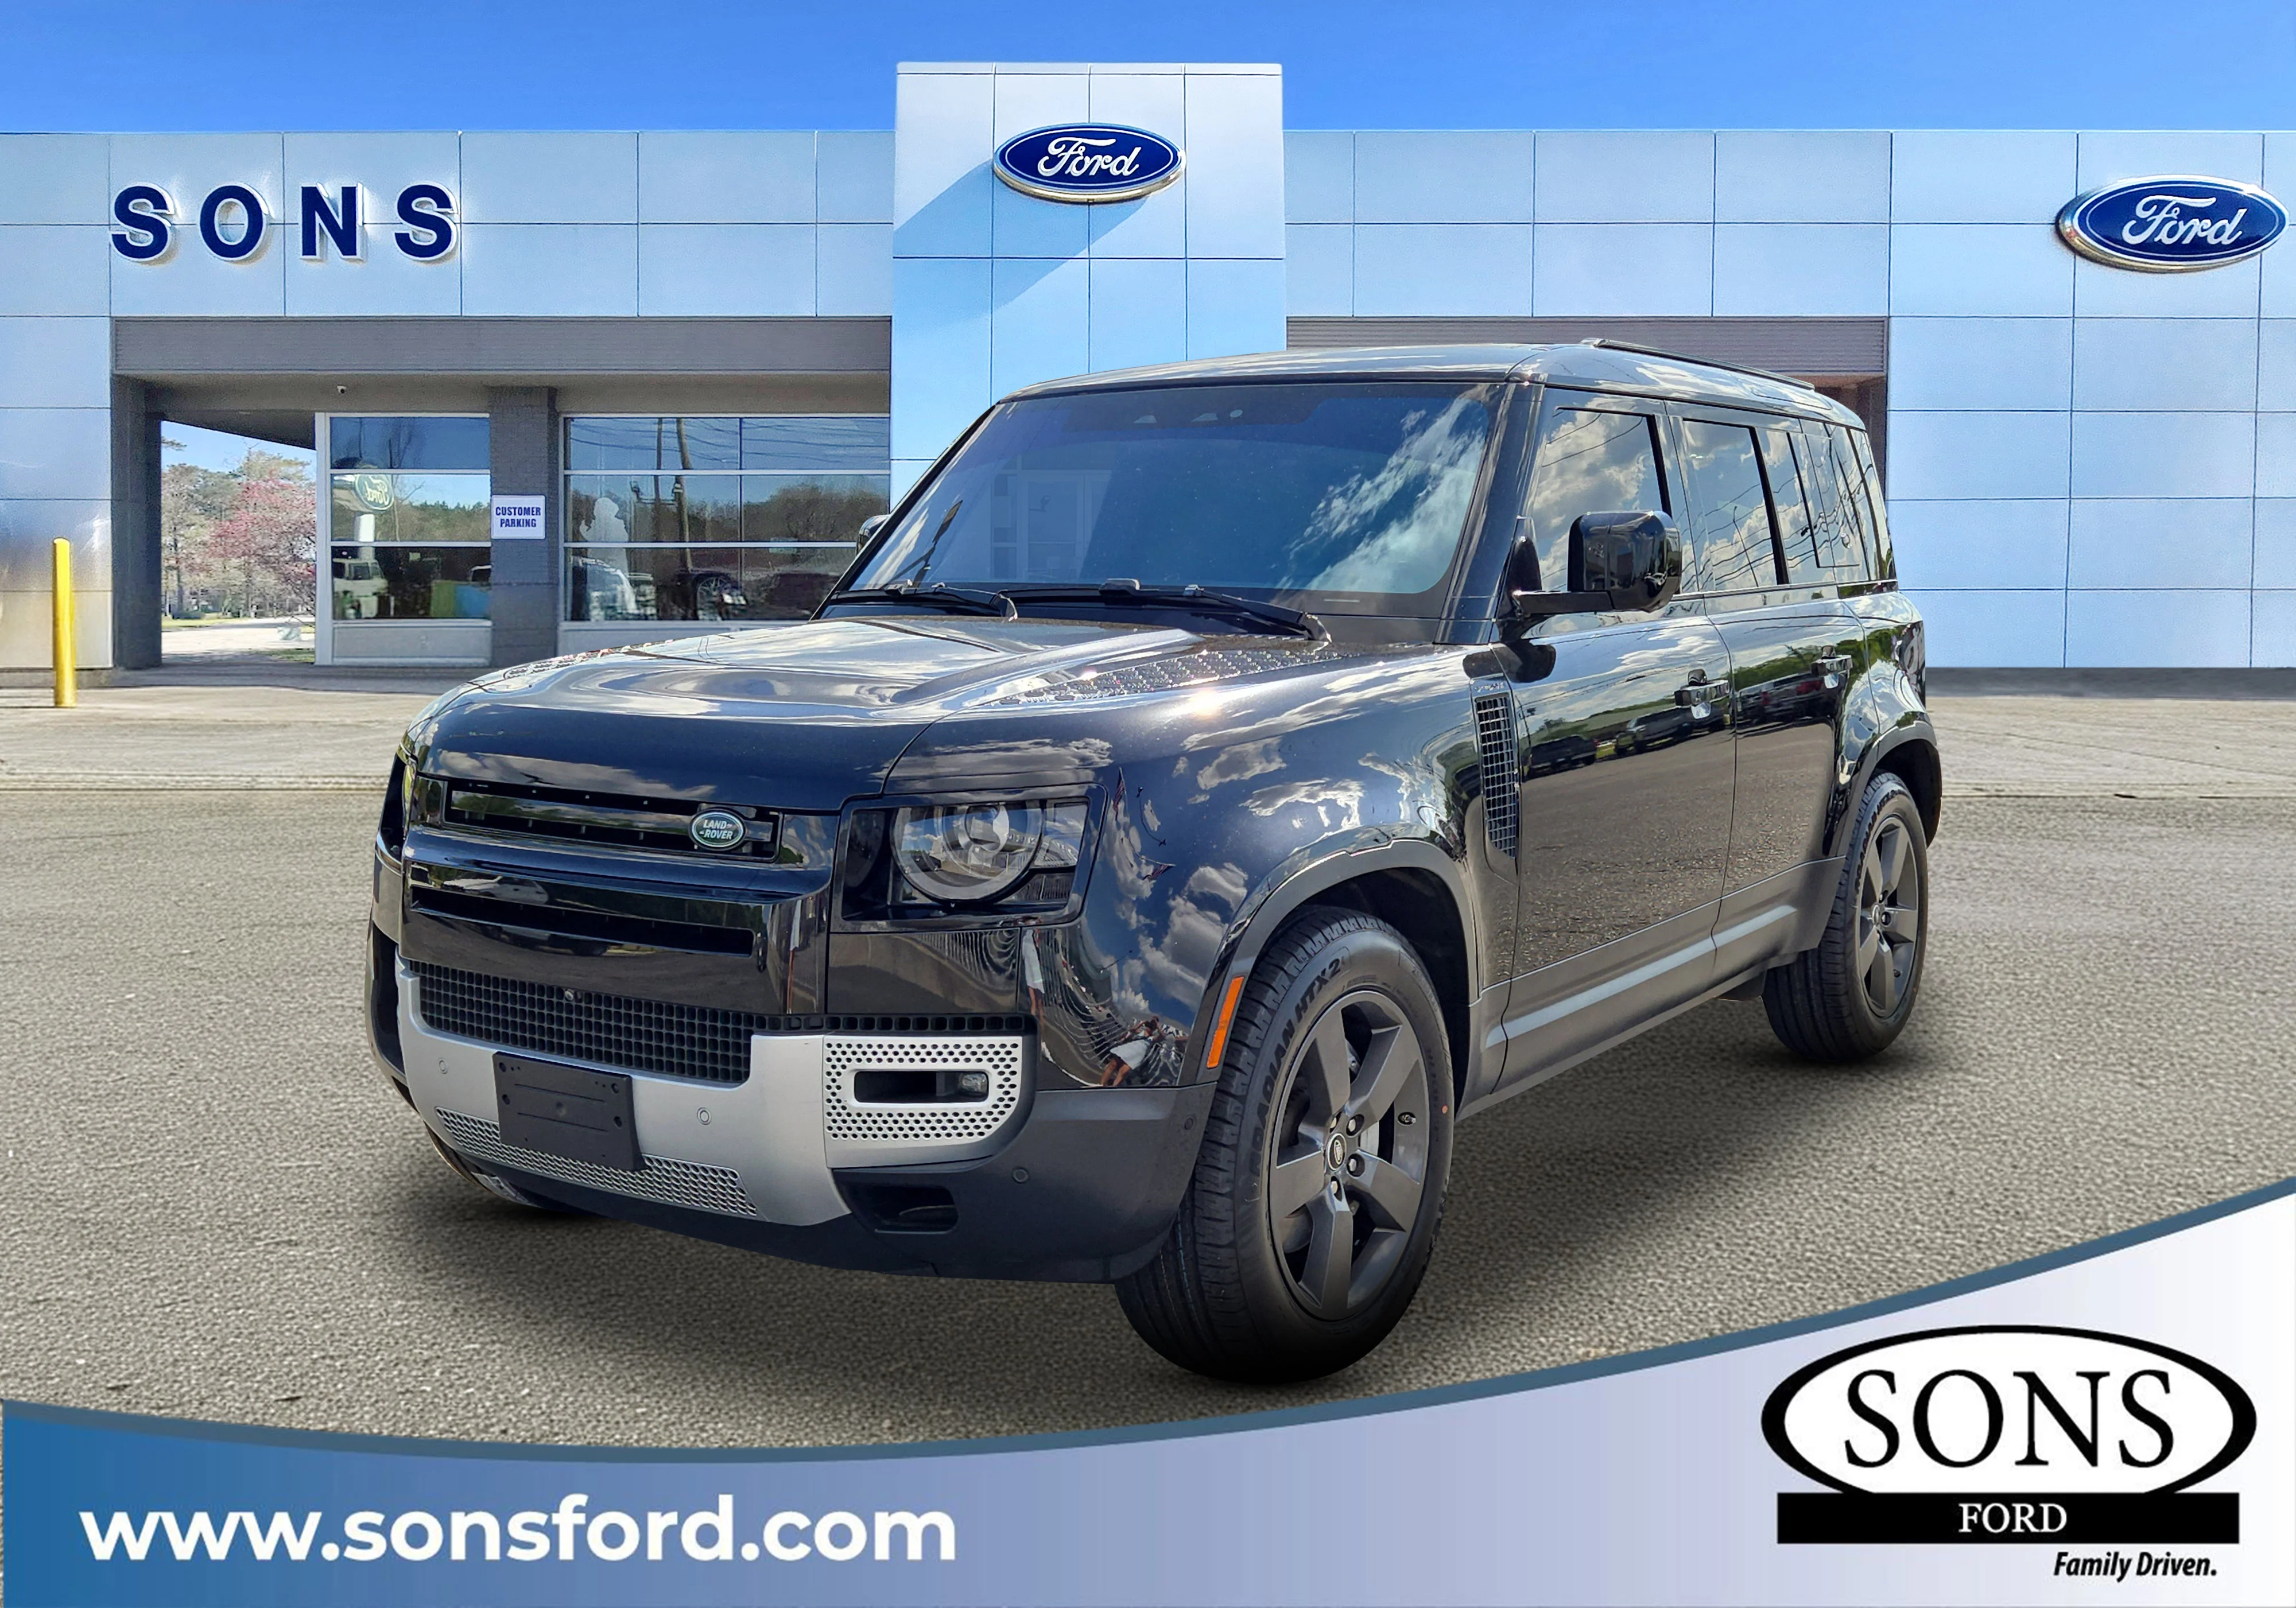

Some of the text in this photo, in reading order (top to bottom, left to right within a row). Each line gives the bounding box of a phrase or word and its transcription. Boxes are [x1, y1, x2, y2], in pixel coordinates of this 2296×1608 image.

[1037, 137, 1142, 177] Ford
[111, 184, 457, 260] SONS
[2122, 195, 2247, 245] Ford
[495, 507, 541, 516] CUSTOMER
[500, 519, 536, 527] PARKING
[703, 819, 727, 829] LAND
[704, 829, 733, 840] ROVER
